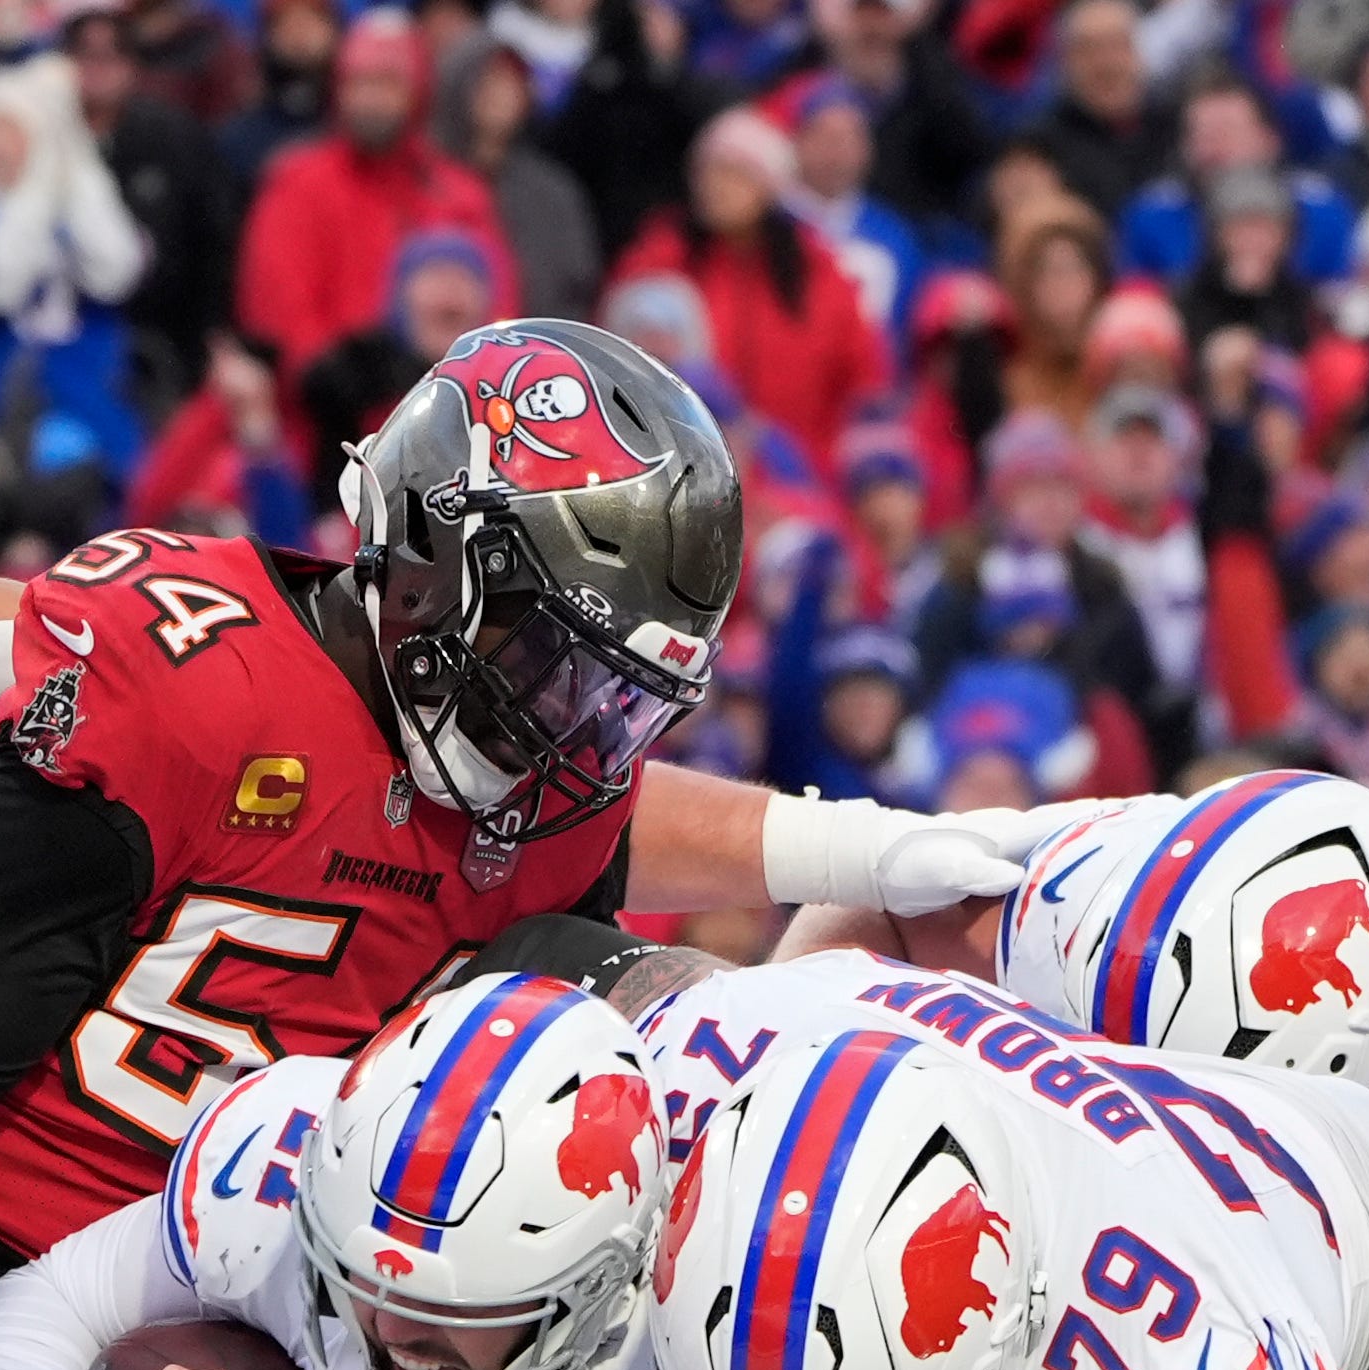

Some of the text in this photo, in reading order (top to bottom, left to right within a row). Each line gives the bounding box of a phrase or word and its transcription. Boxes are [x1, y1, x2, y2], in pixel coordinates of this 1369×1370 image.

[46, 527, 261, 669] 54
[564, 588, 615, 630] OAKLEY
[236, 757, 306, 813] C
[322, 848, 445, 903] BUCCANEERS
[58, 882, 485, 1157] 5
[855, 981, 1156, 1145] BROWN
